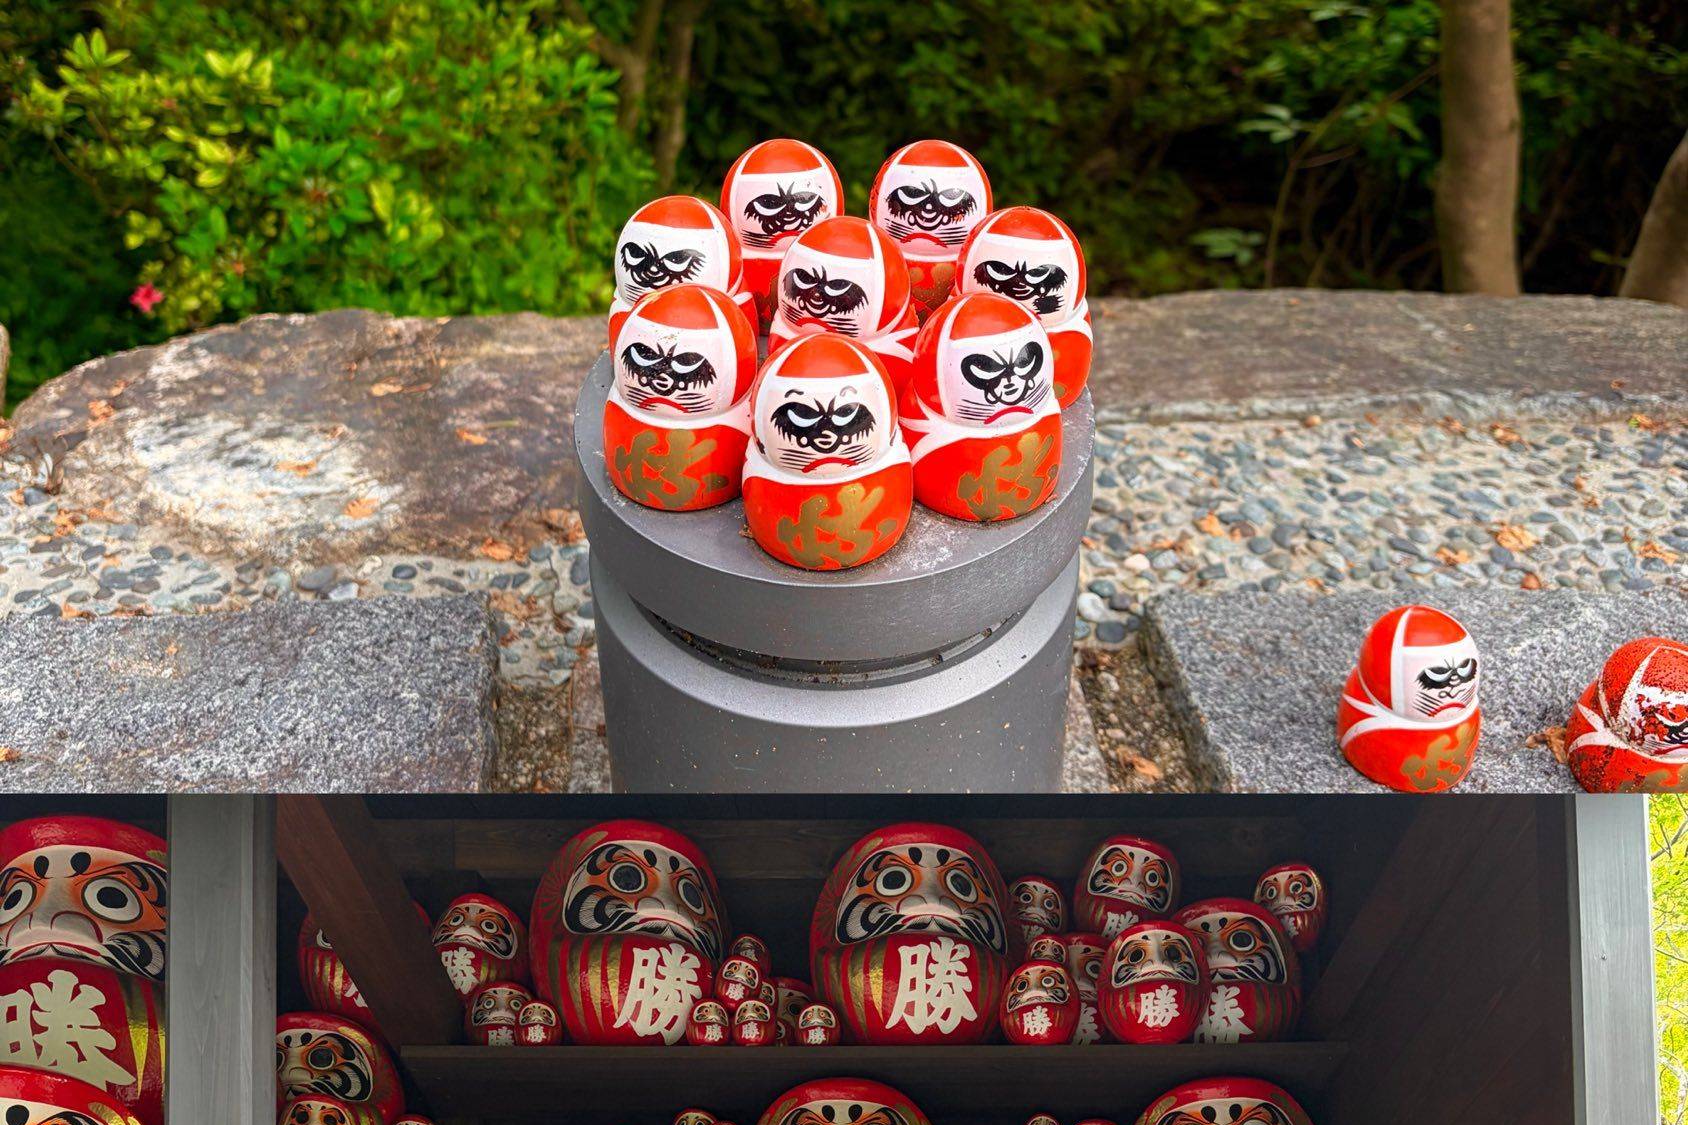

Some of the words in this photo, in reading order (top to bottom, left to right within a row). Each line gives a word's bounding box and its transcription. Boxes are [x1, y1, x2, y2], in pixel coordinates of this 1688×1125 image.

[441, 946, 480, 995] 勝
[613, 943, 702, 1045] 勝
[885, 936, 978, 1034] 勝
[1022, 1004, 1053, 1036] 勝
[1137, 984, 1179, 1028] 勝
